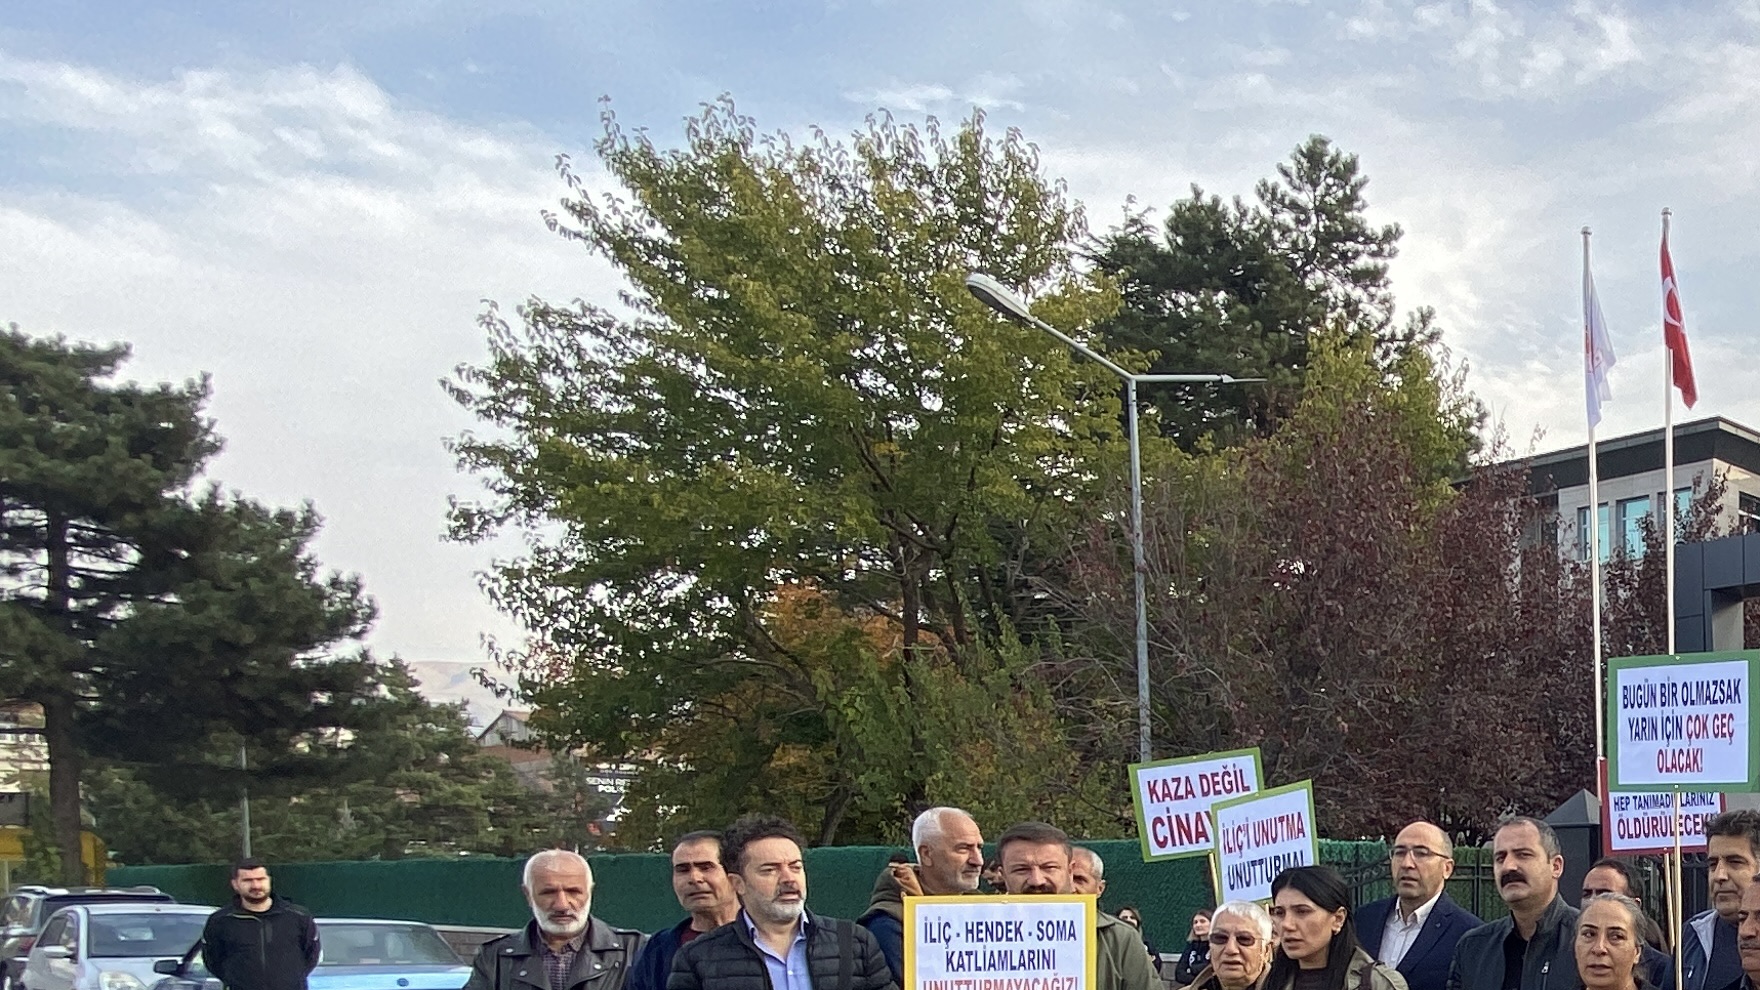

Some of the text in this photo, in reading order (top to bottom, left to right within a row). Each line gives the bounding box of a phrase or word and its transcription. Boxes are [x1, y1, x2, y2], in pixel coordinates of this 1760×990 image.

[1622, 676, 1742, 709] BUGÜN BİR OLMAZSAK
[1628, 709, 1735, 747] YARIN İÇİN ÇOK GEÇ
[1657, 748, 1703, 773] OLACAK!
[1147, 763, 1251, 803] KAZA DEĞİL
[1613, 792, 1715, 811] HEP TANIMADILARINIZ
[1253, 812, 1306, 848] UNUTMA
[924, 916, 952, 949] İLİÇ
[965, 920, 1024, 943] HENDEK
[1036, 920, 1077, 942] SOMA
[945, 945, 1056, 972] KATLİAMLARINI
